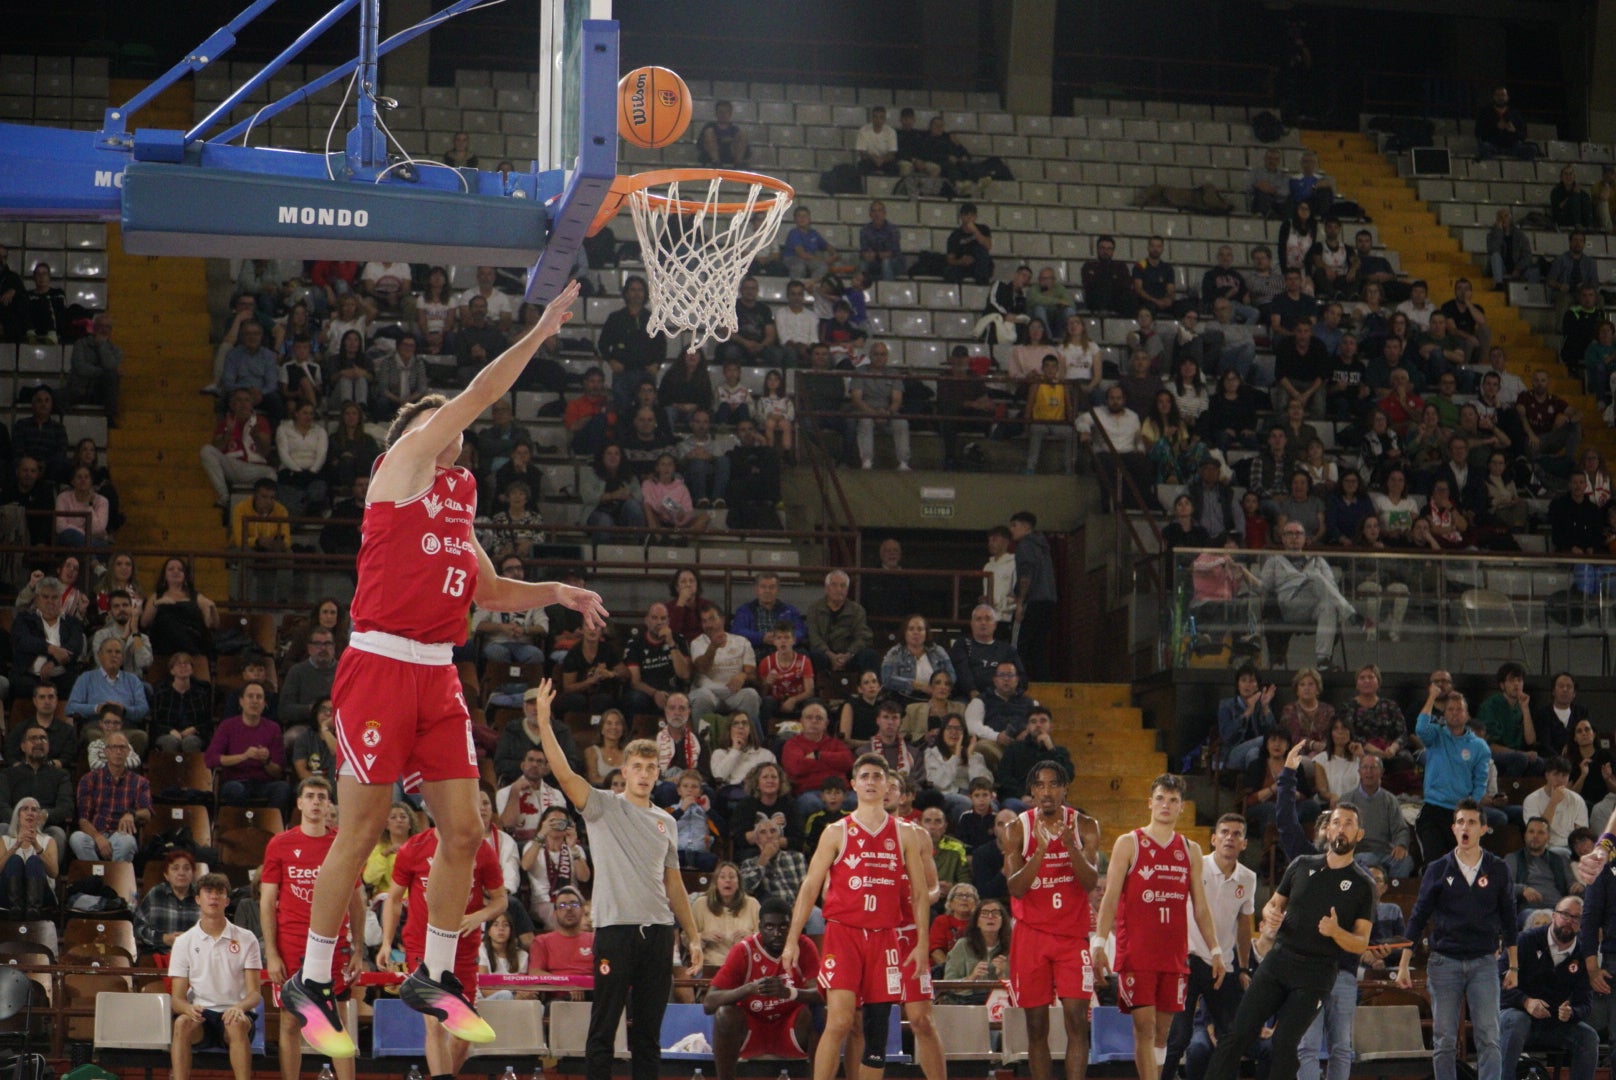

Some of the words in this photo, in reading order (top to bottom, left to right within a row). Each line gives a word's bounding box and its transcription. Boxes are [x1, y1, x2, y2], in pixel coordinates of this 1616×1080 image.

[632, 73, 647, 126] Wilson
[278, 206, 369, 228] MONDO
[442, 566, 467, 597] 13
[863, 894, 877, 912] 10
[1052, 892, 1063, 909] 6
[1159, 906, 1170, 924] 11
[885, 948, 899, 966] 10
[1080, 949, 1091, 966] 6
